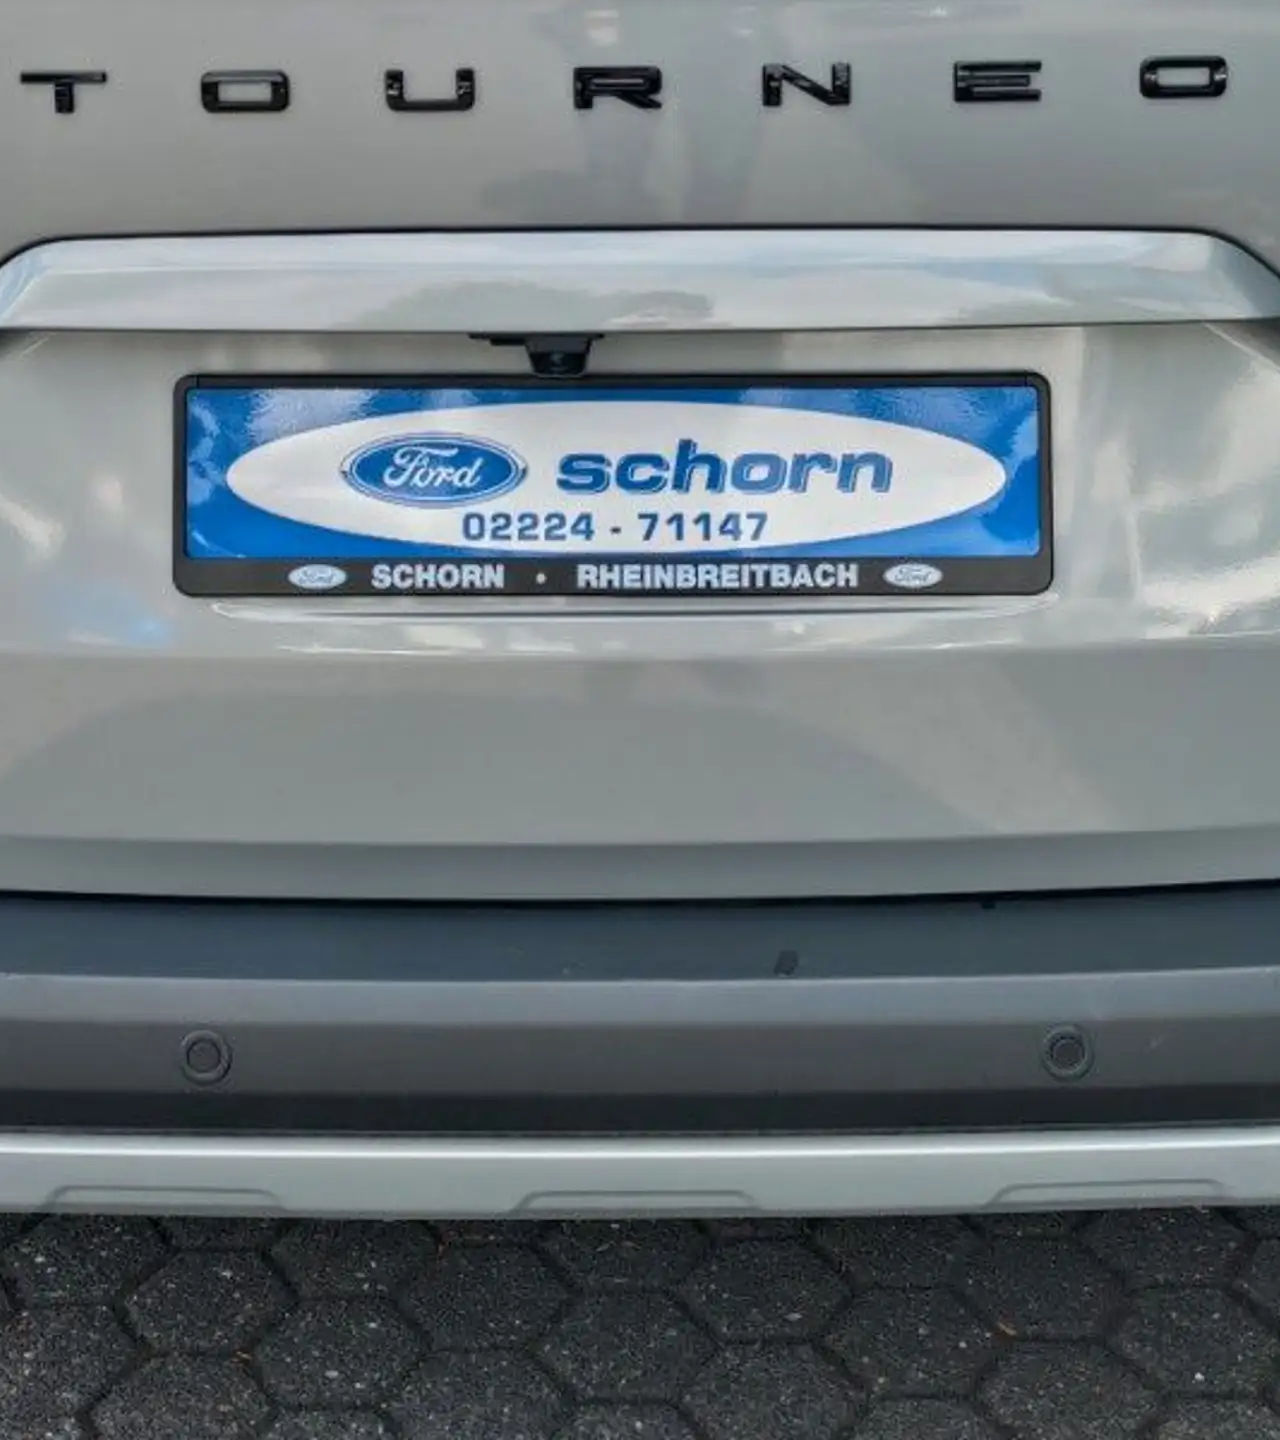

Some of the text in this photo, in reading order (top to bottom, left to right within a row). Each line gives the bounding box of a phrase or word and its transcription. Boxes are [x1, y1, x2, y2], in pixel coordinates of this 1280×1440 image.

[19, 56, 1228, 114] TOURNEO
[383, 438, 894, 496] Ford schorn
[462, 512, 596, 542] 02224
[637, 512, 770, 542] 71147
[371, 564, 505, 590] SCHORN
[577, 563, 860, 590] RHEINBREITBACH
